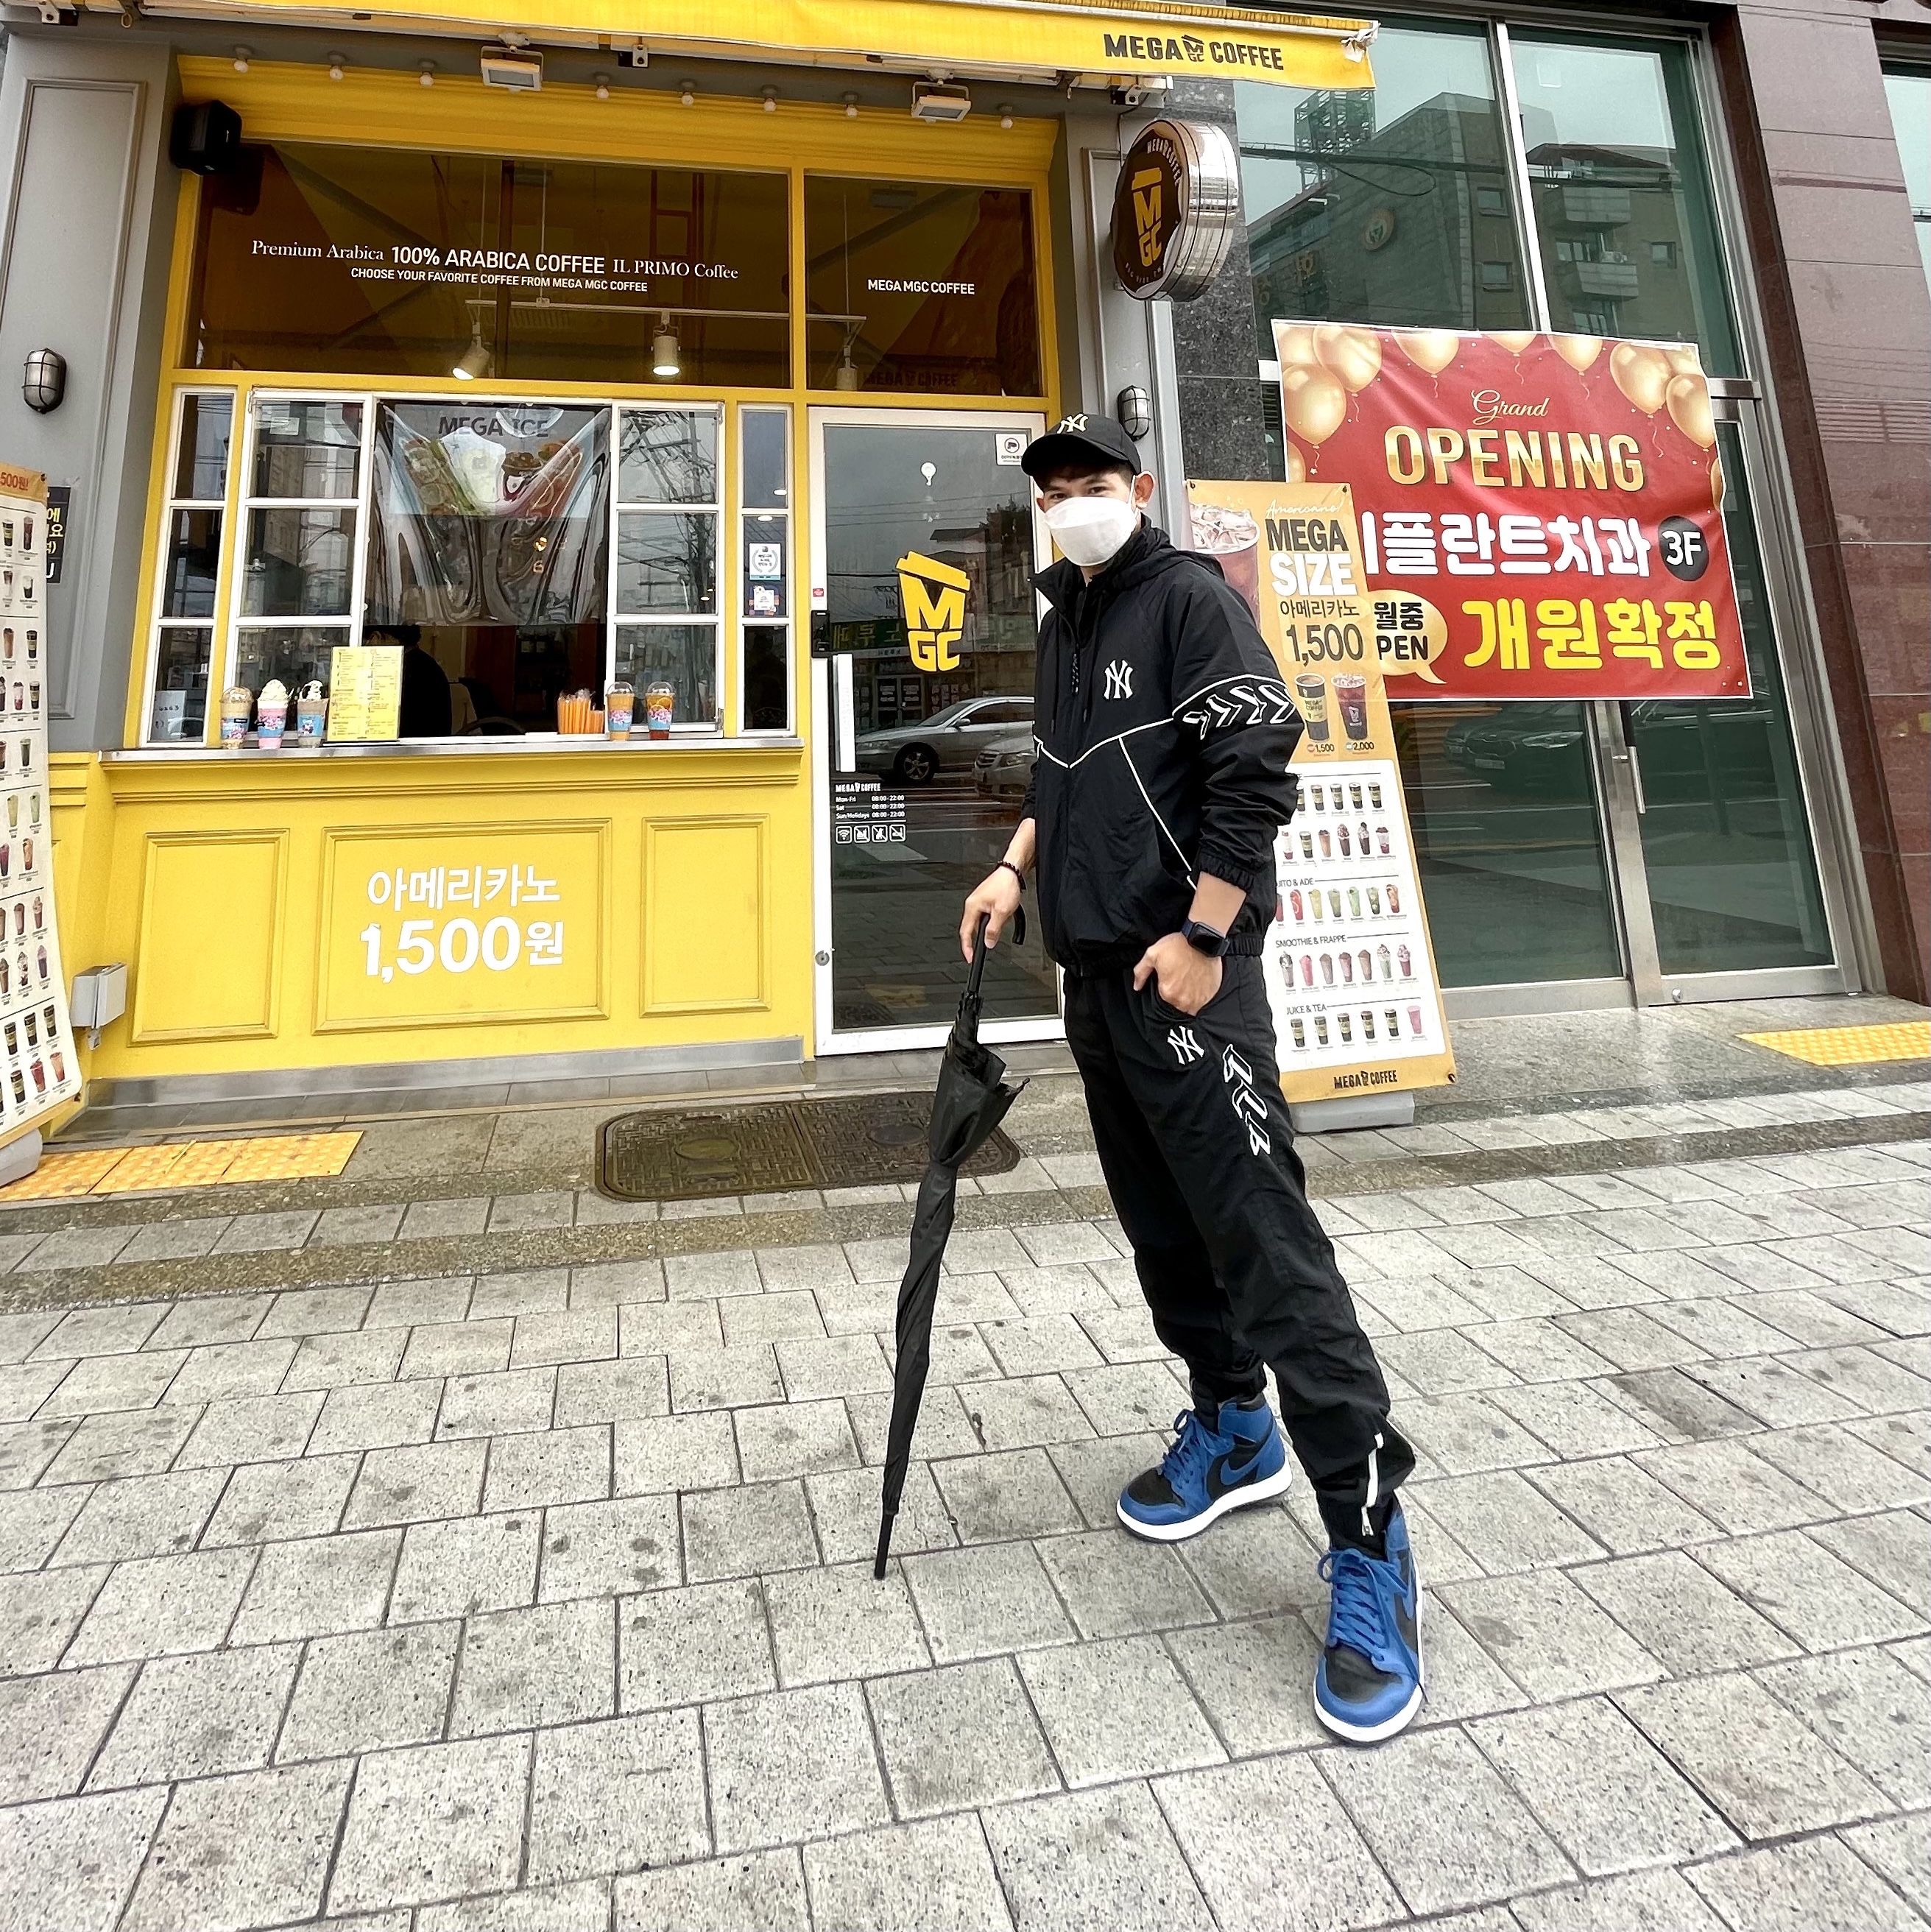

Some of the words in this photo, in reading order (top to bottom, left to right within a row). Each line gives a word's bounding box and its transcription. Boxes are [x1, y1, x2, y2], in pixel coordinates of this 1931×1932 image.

[1104, 34, 1183, 60] MEGA
[1210, 41, 1284, 71] COFFEE
[252, 240, 322, 258] Premium
[327, 244, 384, 261] Arabica
[392, 246, 440, 266] 100%
[445, 249, 530, 271] ARABICA
[535, 253, 605, 274] COFFEE
[613, 258, 631, 273] IL
[634, 260, 690, 277] PRIMO
[694, 263, 738, 280] Coffee
[351, 267, 395, 279] CHOOSE
[397, 269, 426, 281] YOUR
[428, 271, 478, 283] FAVORITE
[480, 273, 519, 285] COFFEE
[521, 277, 550, 287] FROM
[552, 278, 582, 289] MEGA
[585, 280, 608, 290] MGC
[610, 281, 648, 292] COFFEE
[867, 279, 902, 292] MEGA
[903, 281, 930, 293] MGC
[931, 282, 975, 295] COFFEE
[1056, 413, 1089, 434] NY
[1472, 389, 1549, 424] Grand
[1383, 425, 1646, 492] OPENING
[1265, 518, 1349, 552] MEGA
[1662, 529, 1702, 566] 3F
[1270, 552, 1358, 596] SIZE
[1280, 599, 1360, 619] 아메리카노
[1374, 602, 1424, 630] 월중
[1287, 623, 1363, 667] 1,500
[1376, 635, 1428, 660] PEN
[1461, 597, 1723, 670] 개원확정
[1104, 660, 1134, 699] NY
[1315, 744, 1335, 753] 1,500
[1353, 742, 1374, 751] 2,000
[836, 784, 855, 793] MEGA
[861, 783, 881, 792] COFFEE
[367, 864, 561, 912] 아메리카노
[1278, 879, 1292, 887] JITO
[359, 916, 564, 984] 1,500원
[1319, 934, 1346, 944] FRAPPE
[1286, 1005, 1305, 1015] JUICE
[1313, 1004, 1327, 1012] TEA
[1168, 1026, 1205, 1065] NY
[1334, 1074, 1362, 1090] MEGA
[1369, 1069, 1398, 1085] COFFEE
